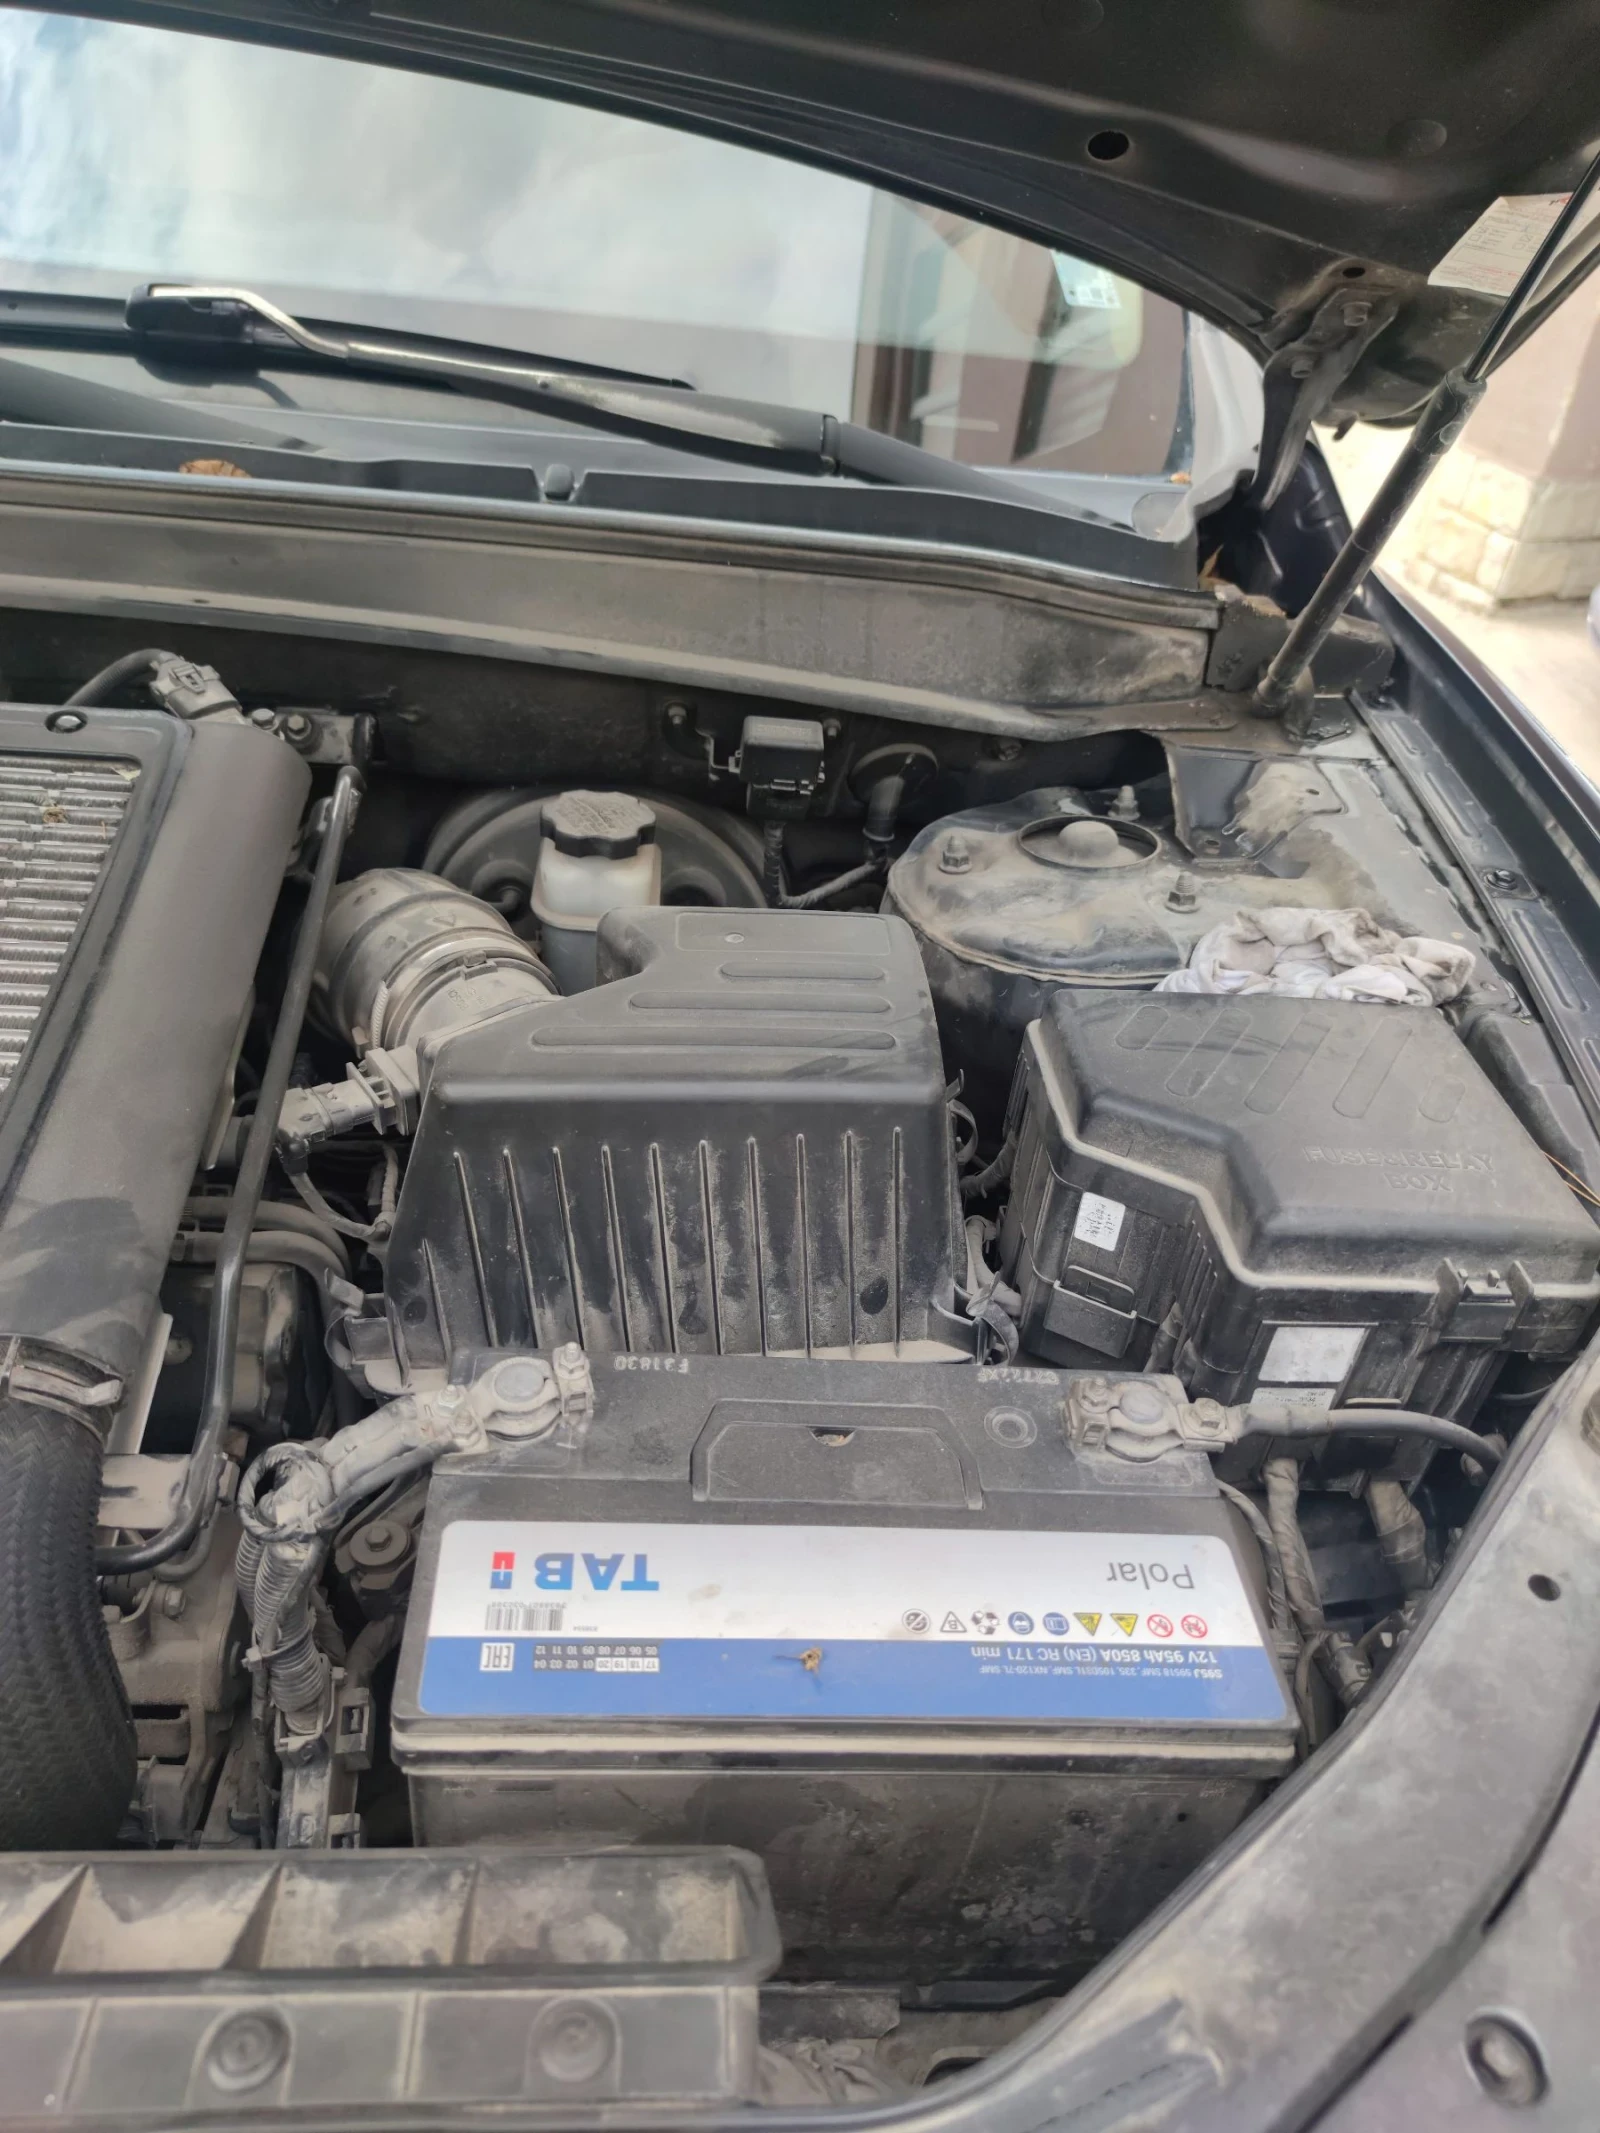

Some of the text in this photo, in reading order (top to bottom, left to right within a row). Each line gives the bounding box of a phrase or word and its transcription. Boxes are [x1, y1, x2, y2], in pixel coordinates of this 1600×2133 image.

[1385, 1173, 1452, 1192] BOX
[534, 1553, 660, 1591] TAB
[1107, 1562, 1195, 1590] Polar
[536, 1645, 658, 1655] 05 06 07 08 09 10 11 12
[971, 1645, 1217, 1663] 12V 95Ah 850A (EN) RC 171 min
[534, 1659, 656, 1669] 17 18 19 20 01 02 03 04
[1193, 1668, 1223, 1678] S95J
